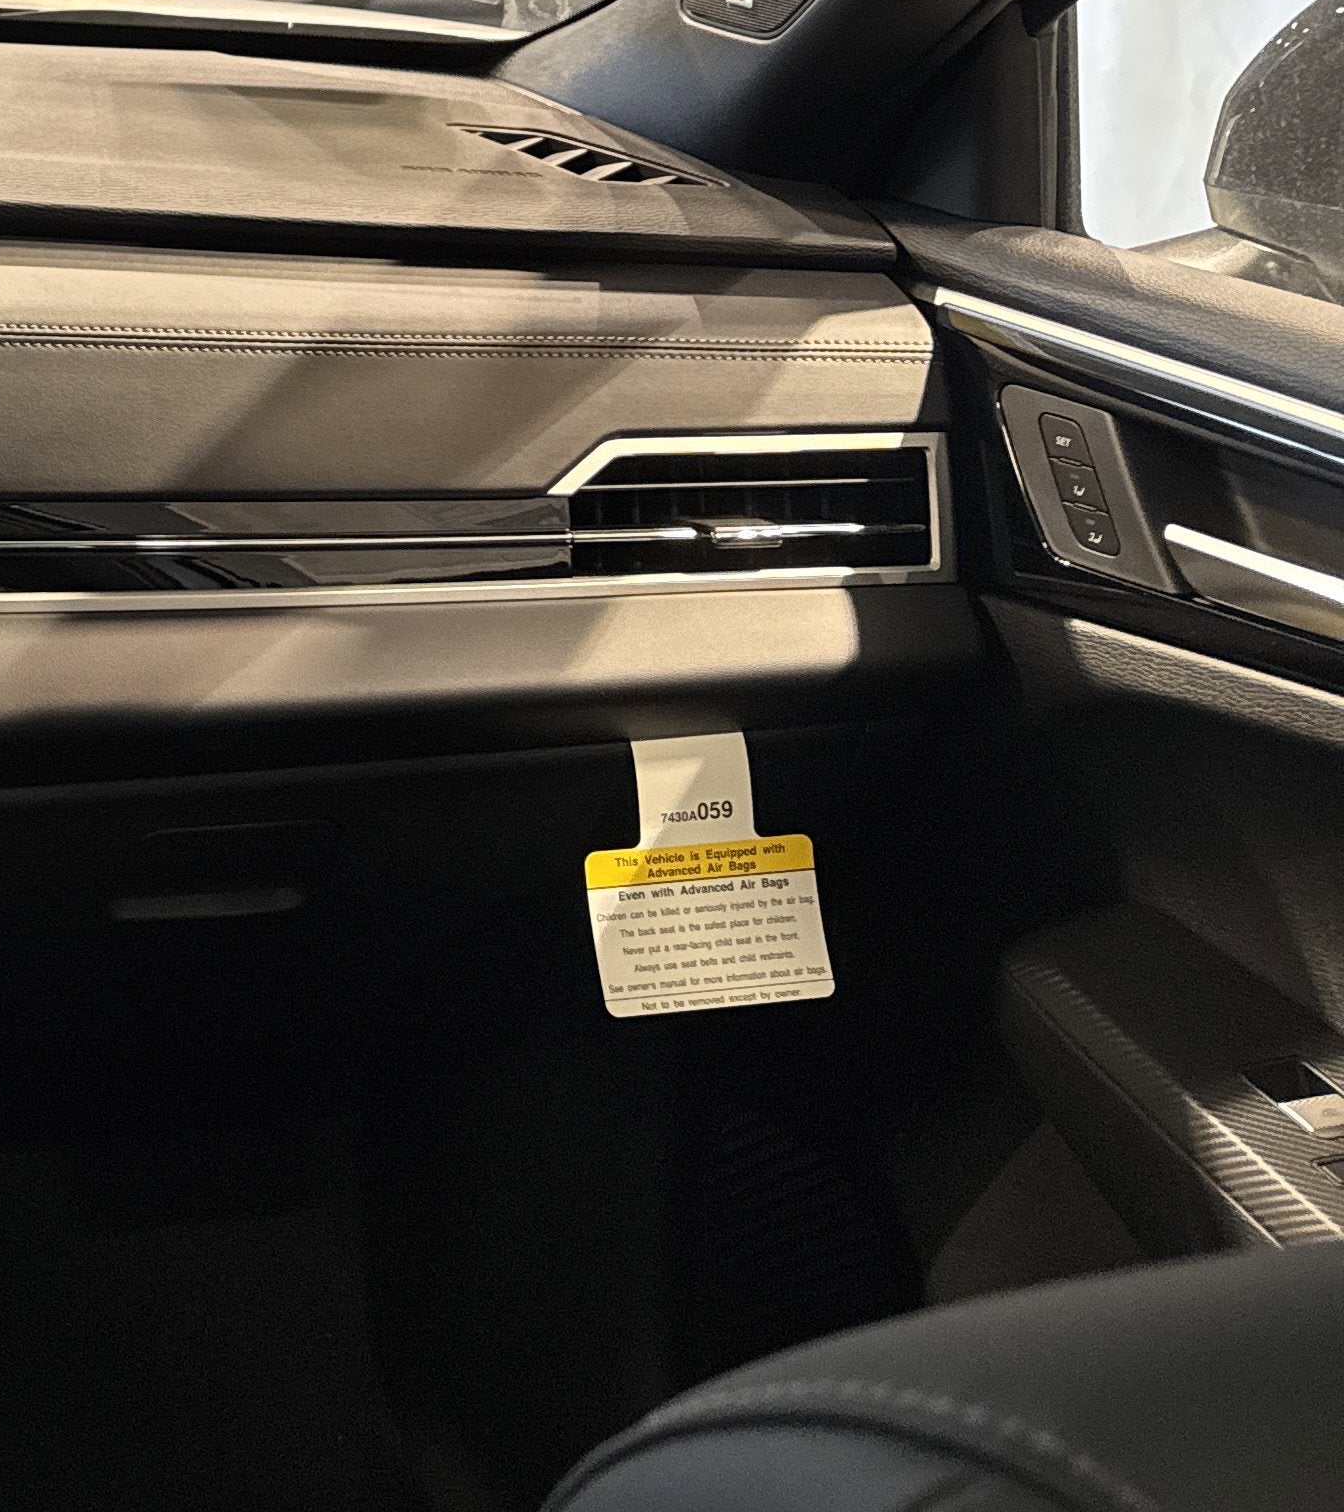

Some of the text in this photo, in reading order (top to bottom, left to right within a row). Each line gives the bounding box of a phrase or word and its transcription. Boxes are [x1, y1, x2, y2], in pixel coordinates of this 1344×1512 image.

[1056, 436, 1072, 447] SET
[661, 799, 734, 824] 7430A059
[615, 843, 785, 868] This Vehicle is Equipped with
[647, 860, 757, 879] Advanced Air Bags
[618, 877, 789, 901] Even with Advanced Air Bags
[648, 909, 657, 917] be
[771, 898, 782, 906] the
